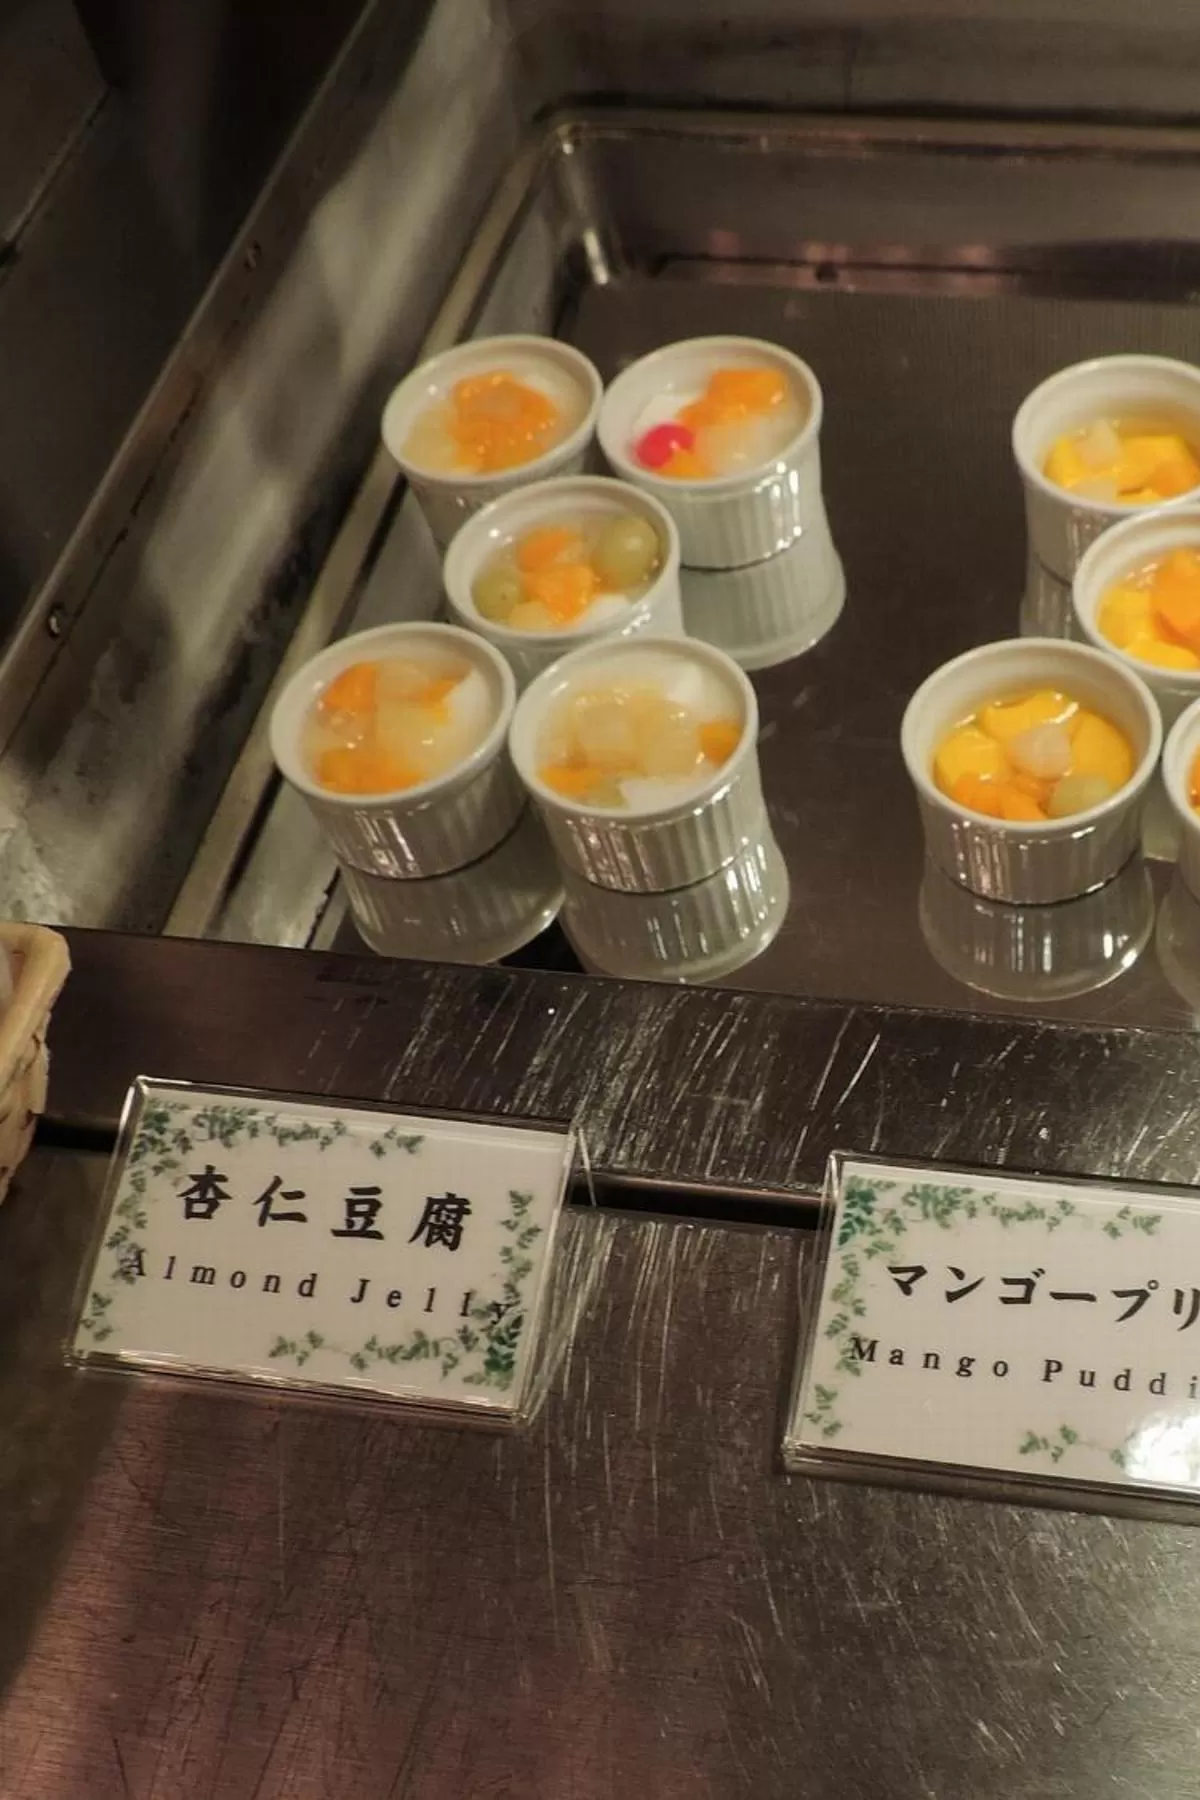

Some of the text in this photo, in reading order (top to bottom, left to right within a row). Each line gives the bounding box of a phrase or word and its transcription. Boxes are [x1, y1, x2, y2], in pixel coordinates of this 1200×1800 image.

[178, 1164, 473, 1251] 杏仁豆腐
[120, 1247, 317, 1298] Almond
[848, 1336, 1010, 1378] Mango
